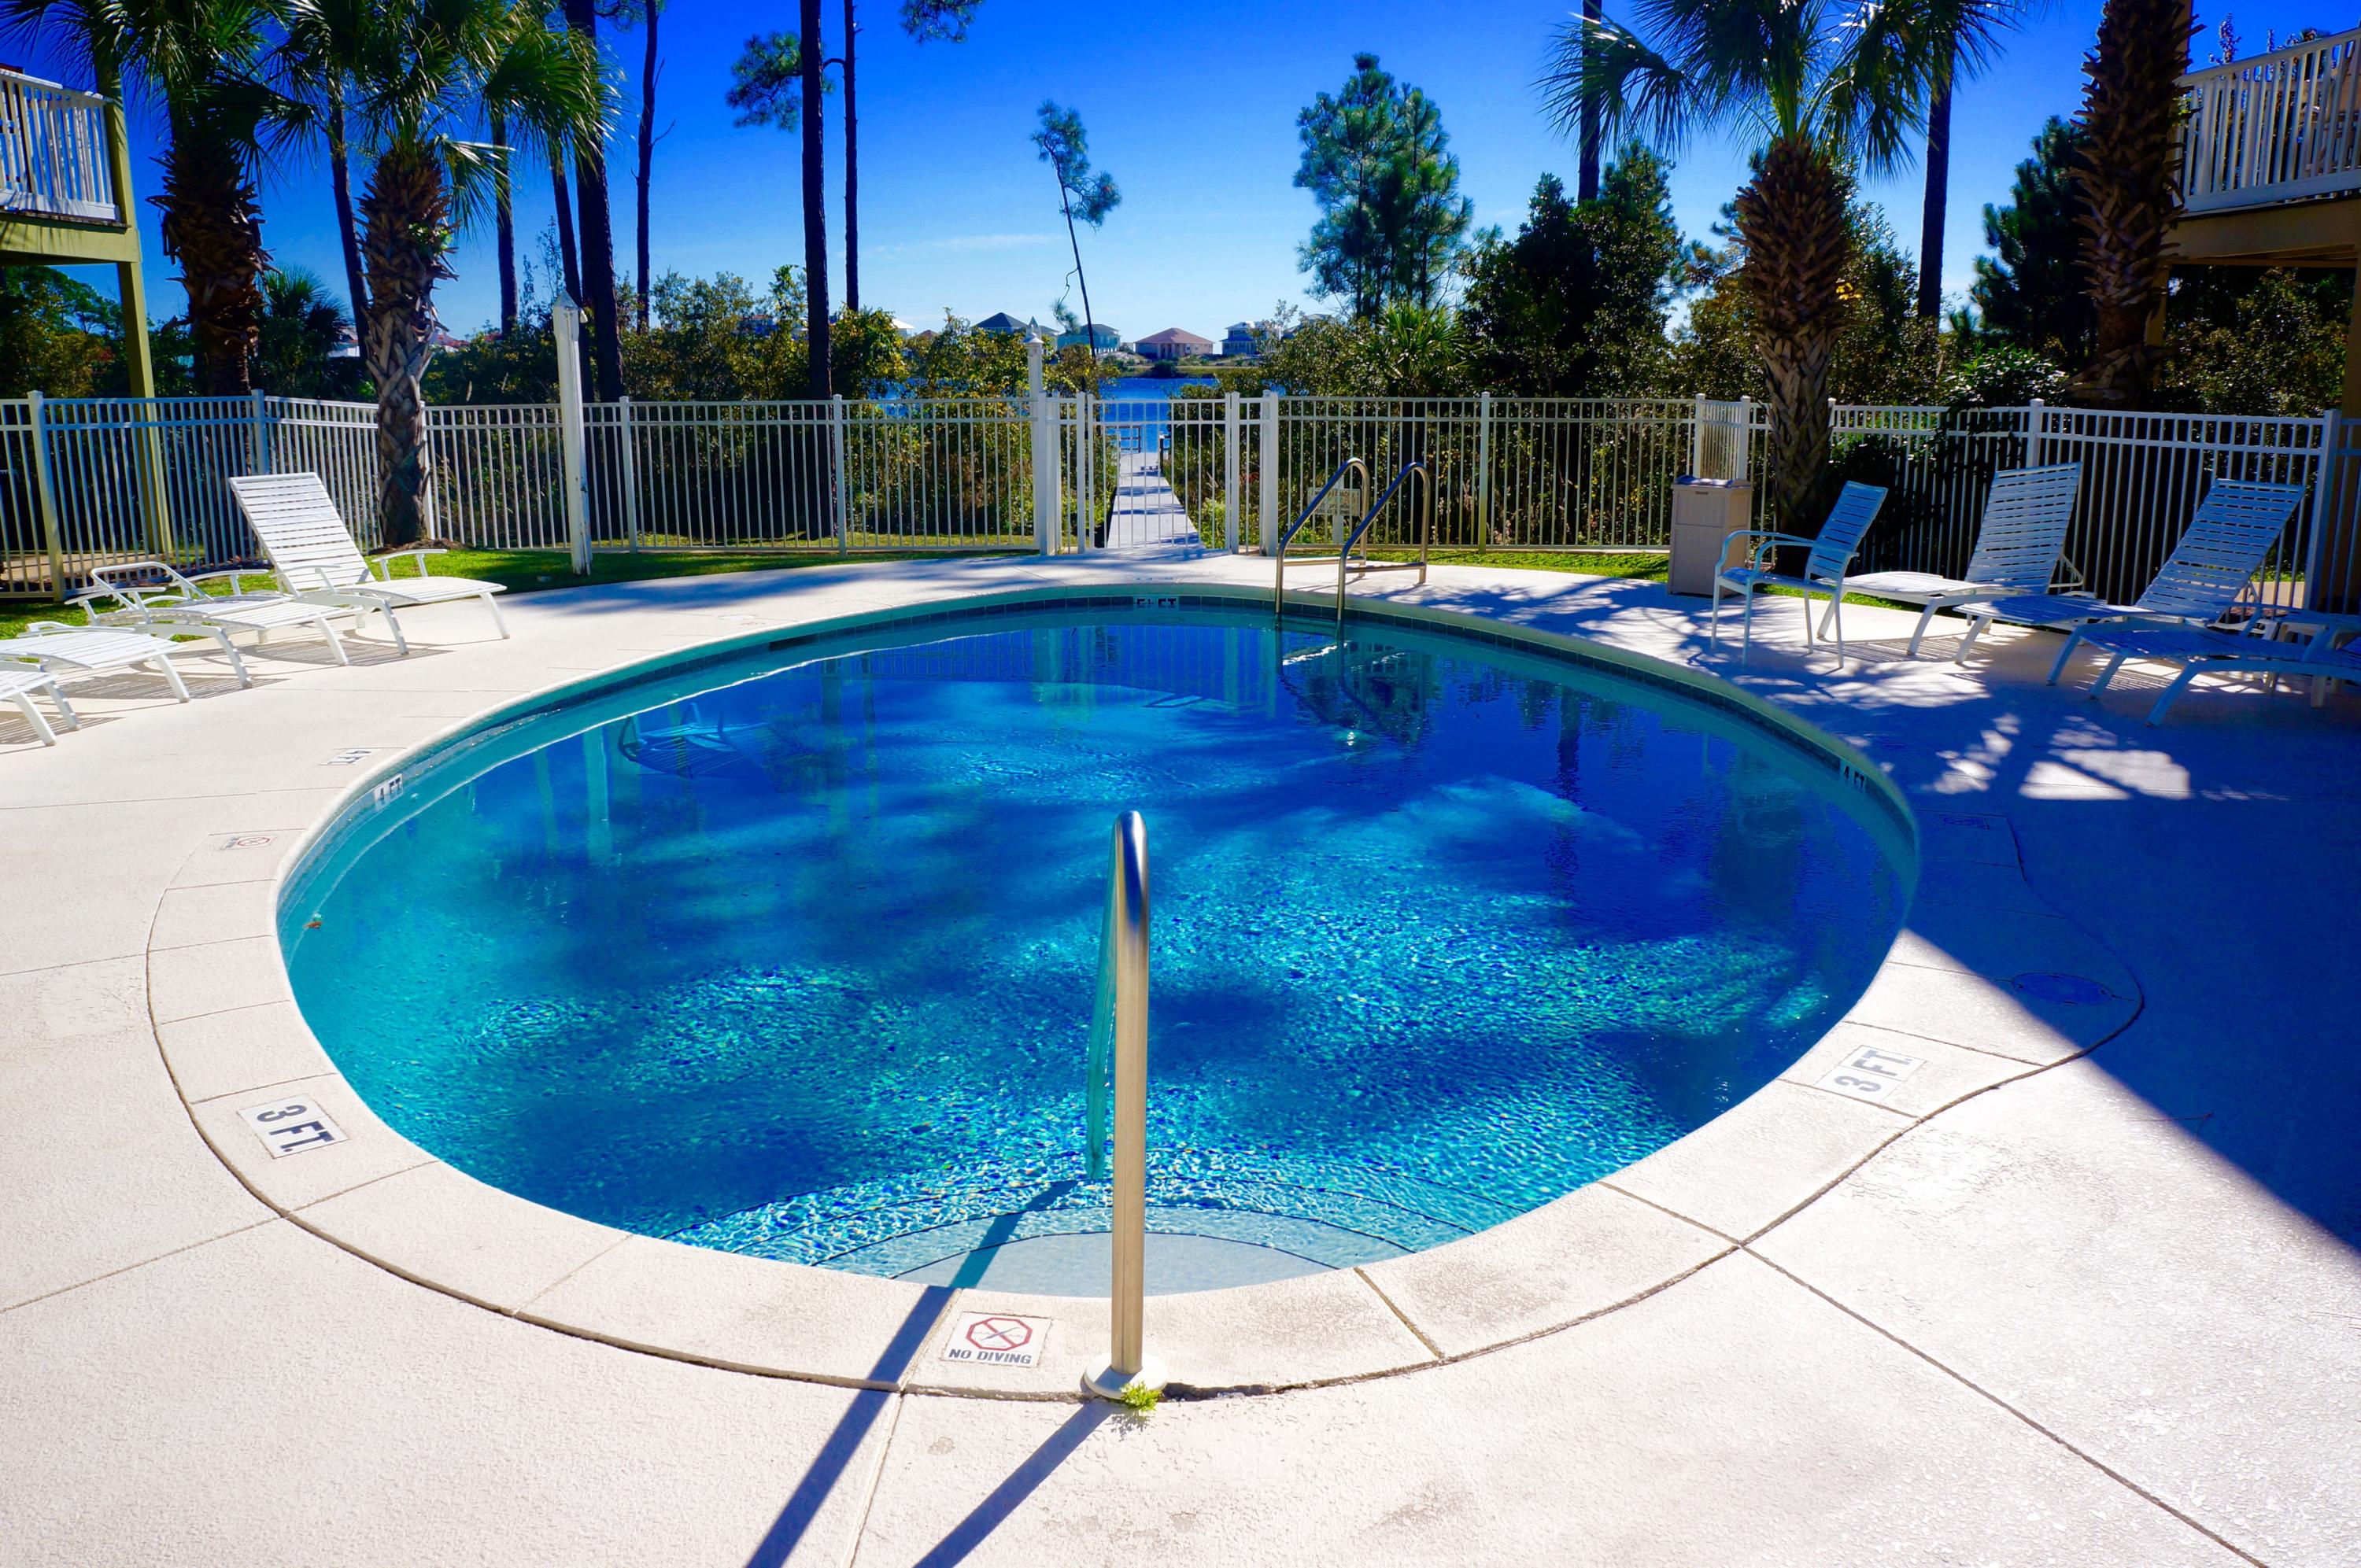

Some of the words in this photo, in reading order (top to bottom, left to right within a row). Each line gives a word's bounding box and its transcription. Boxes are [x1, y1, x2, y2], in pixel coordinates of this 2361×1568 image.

[390, 777, 401, 795] FT
[1834, 1075, 1882, 1093] 3
[257, 1105, 307, 1123] 3
[948, 1348, 972, 1360] NO
[976, 1350, 1033, 1365] DIVING
